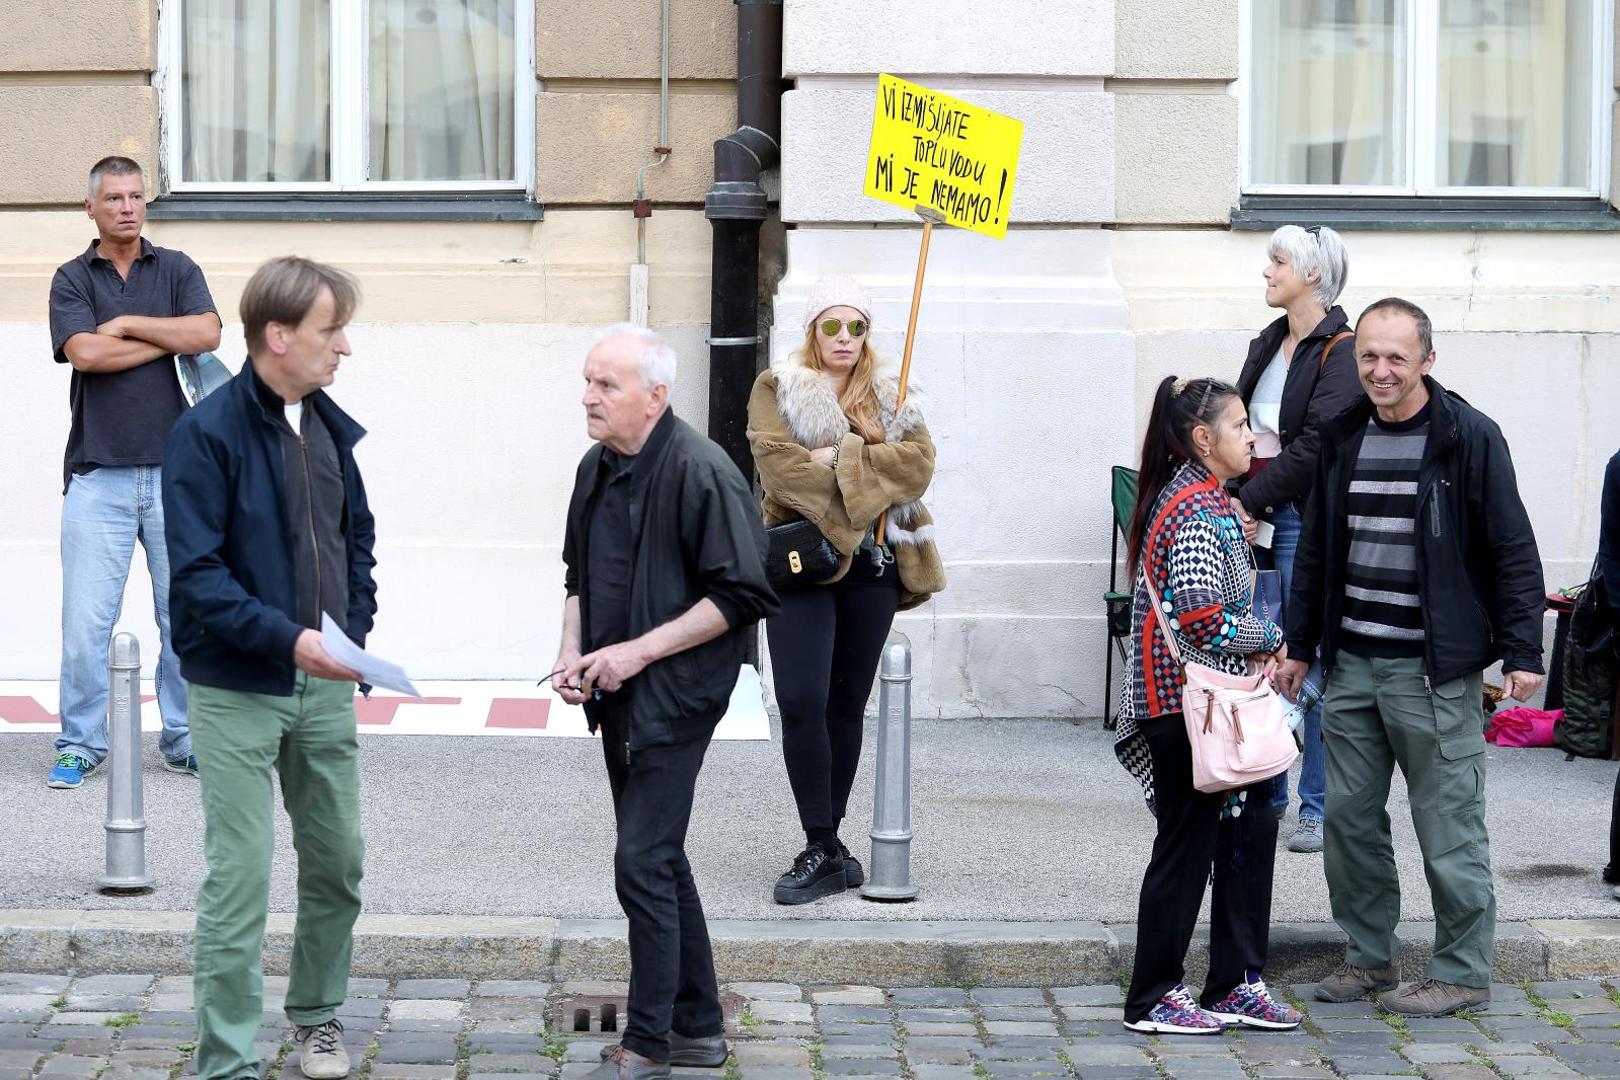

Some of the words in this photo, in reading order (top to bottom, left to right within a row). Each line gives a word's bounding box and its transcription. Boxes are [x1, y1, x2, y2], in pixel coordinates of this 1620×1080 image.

[875, 153, 894, 192] MI
[900, 167, 920, 199] JE
[913, 135, 947, 169] TOPLU
[949, 149, 986, 186] VODU
